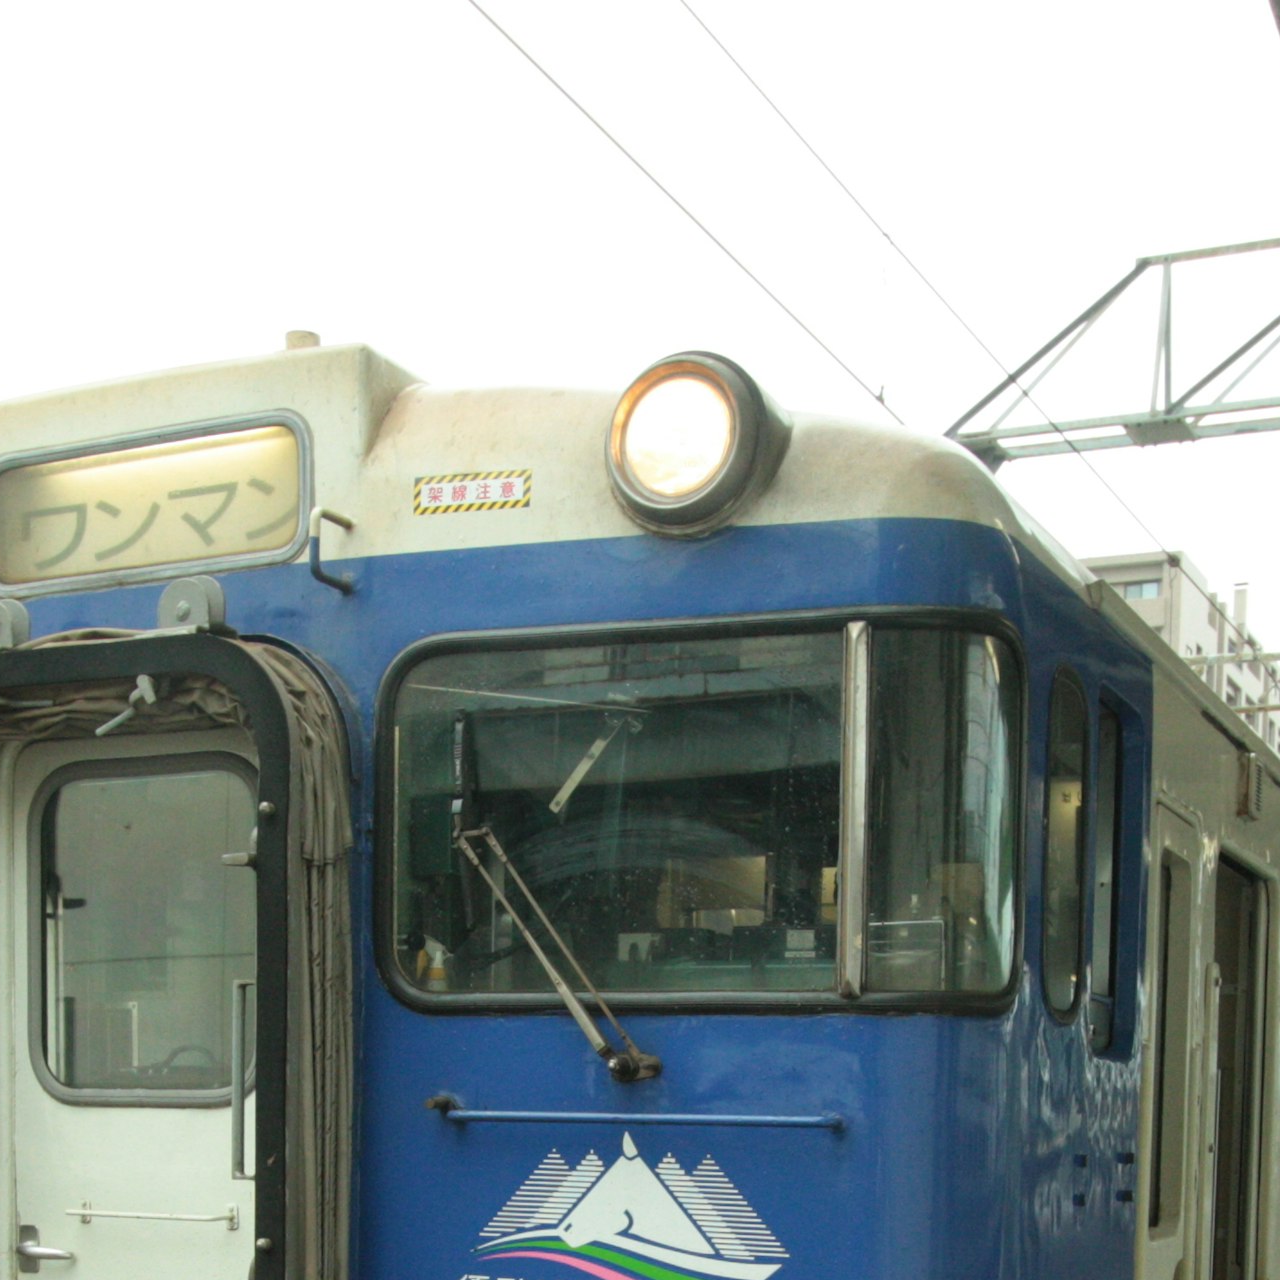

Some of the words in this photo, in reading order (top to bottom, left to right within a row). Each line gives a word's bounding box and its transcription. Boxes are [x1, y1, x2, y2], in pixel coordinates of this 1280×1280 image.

[427, 480, 516, 504] 架線注意
[20, 477, 300, 571] ワンマン
